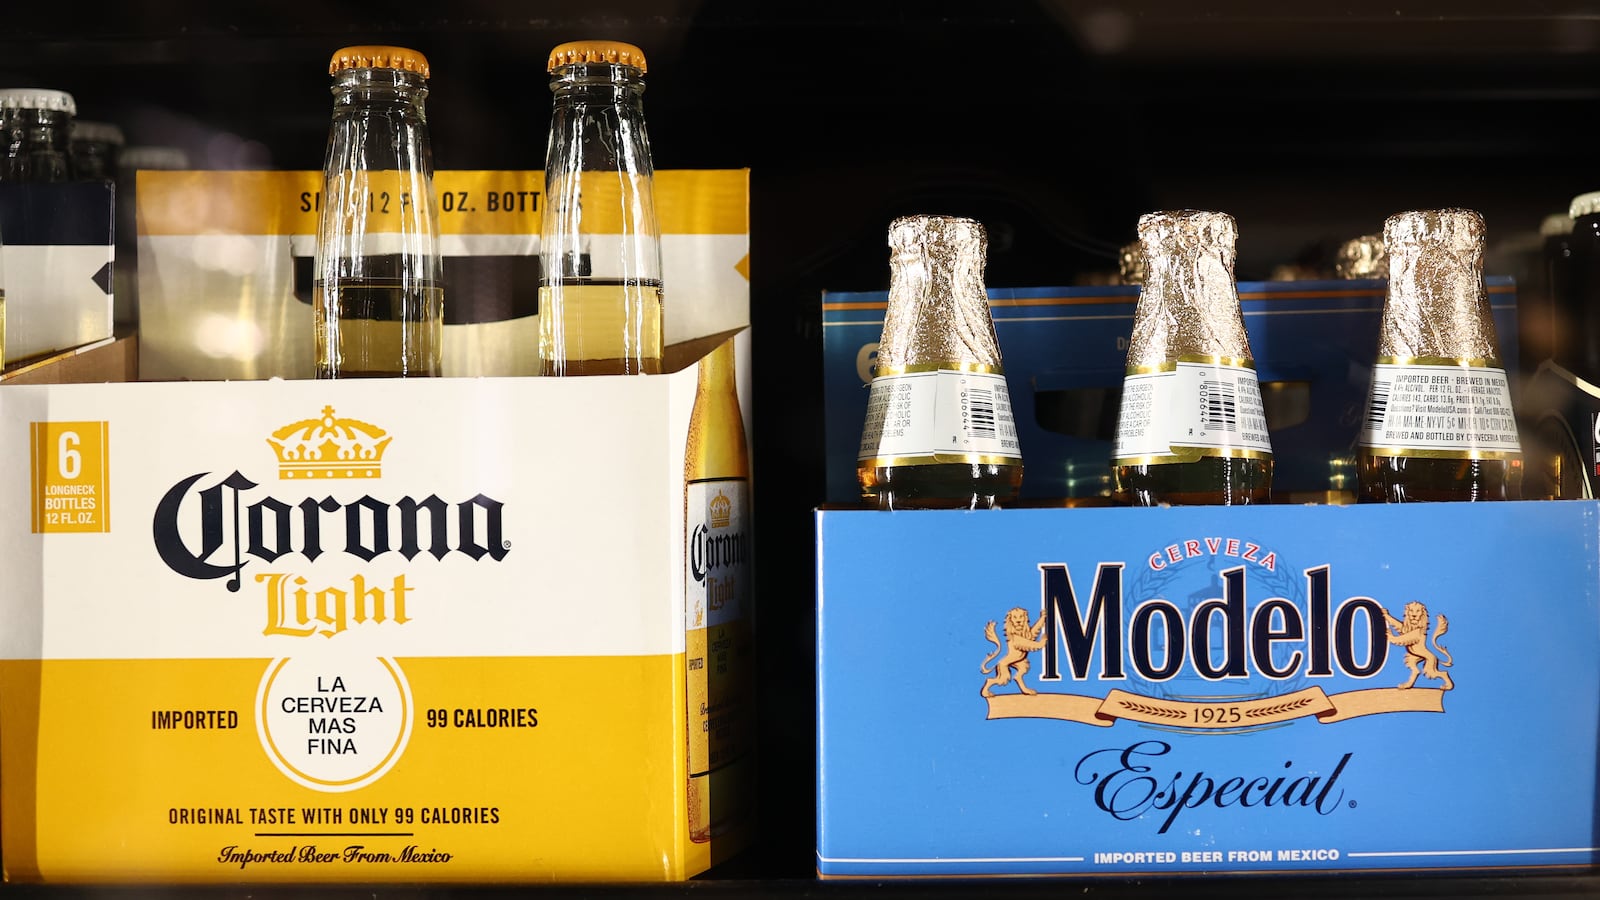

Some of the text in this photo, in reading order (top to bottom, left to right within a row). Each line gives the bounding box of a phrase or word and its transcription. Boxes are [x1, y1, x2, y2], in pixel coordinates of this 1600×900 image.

[442, 192, 477, 212] OZ.
[1396, 375, 1429, 384] IMPORTED
[1431, 376, 1449, 384] BEER
[1456, 377, 1483, 385] BREWED
[1456, 396, 1475, 404] PROTEN
[1410, 431, 1424, 440] AND
[1425, 431, 1454, 441] BOTTLED
[1455, 432, 1465, 441] BY
[58, 430, 81, 480] 6
[45, 485, 96, 495] LONGNECK
[45, 498, 96, 510] BOTTLES
[46, 512, 96, 524] 12 FL. OZ.
[153, 469, 508, 592] Corona
[1149, 537, 1277, 572] CERVEZA
[255, 572, 415, 639] Light
[1038, 561, 1389, 682] Modelo
[317, 676, 346, 692] LA
[281, 696, 383, 714] CERVEZA
[152, 710, 238, 730] IMPORTED
[427, 708, 538, 728] 99 CALORIES
[1193, 707, 1242, 725] 1925
[309, 718, 356, 734] MAS
[308, 738, 357, 755] FINA
[1075, 740, 1353, 835] Especial
[169, 807, 500, 825] ORIGINAL TASTE WITH ONLY 99 CALORIES
[217, 845, 453, 869] Imported Beer From Mexico
[1094, 848, 1340, 864] IMPORTED BEER FROM MEXICO
